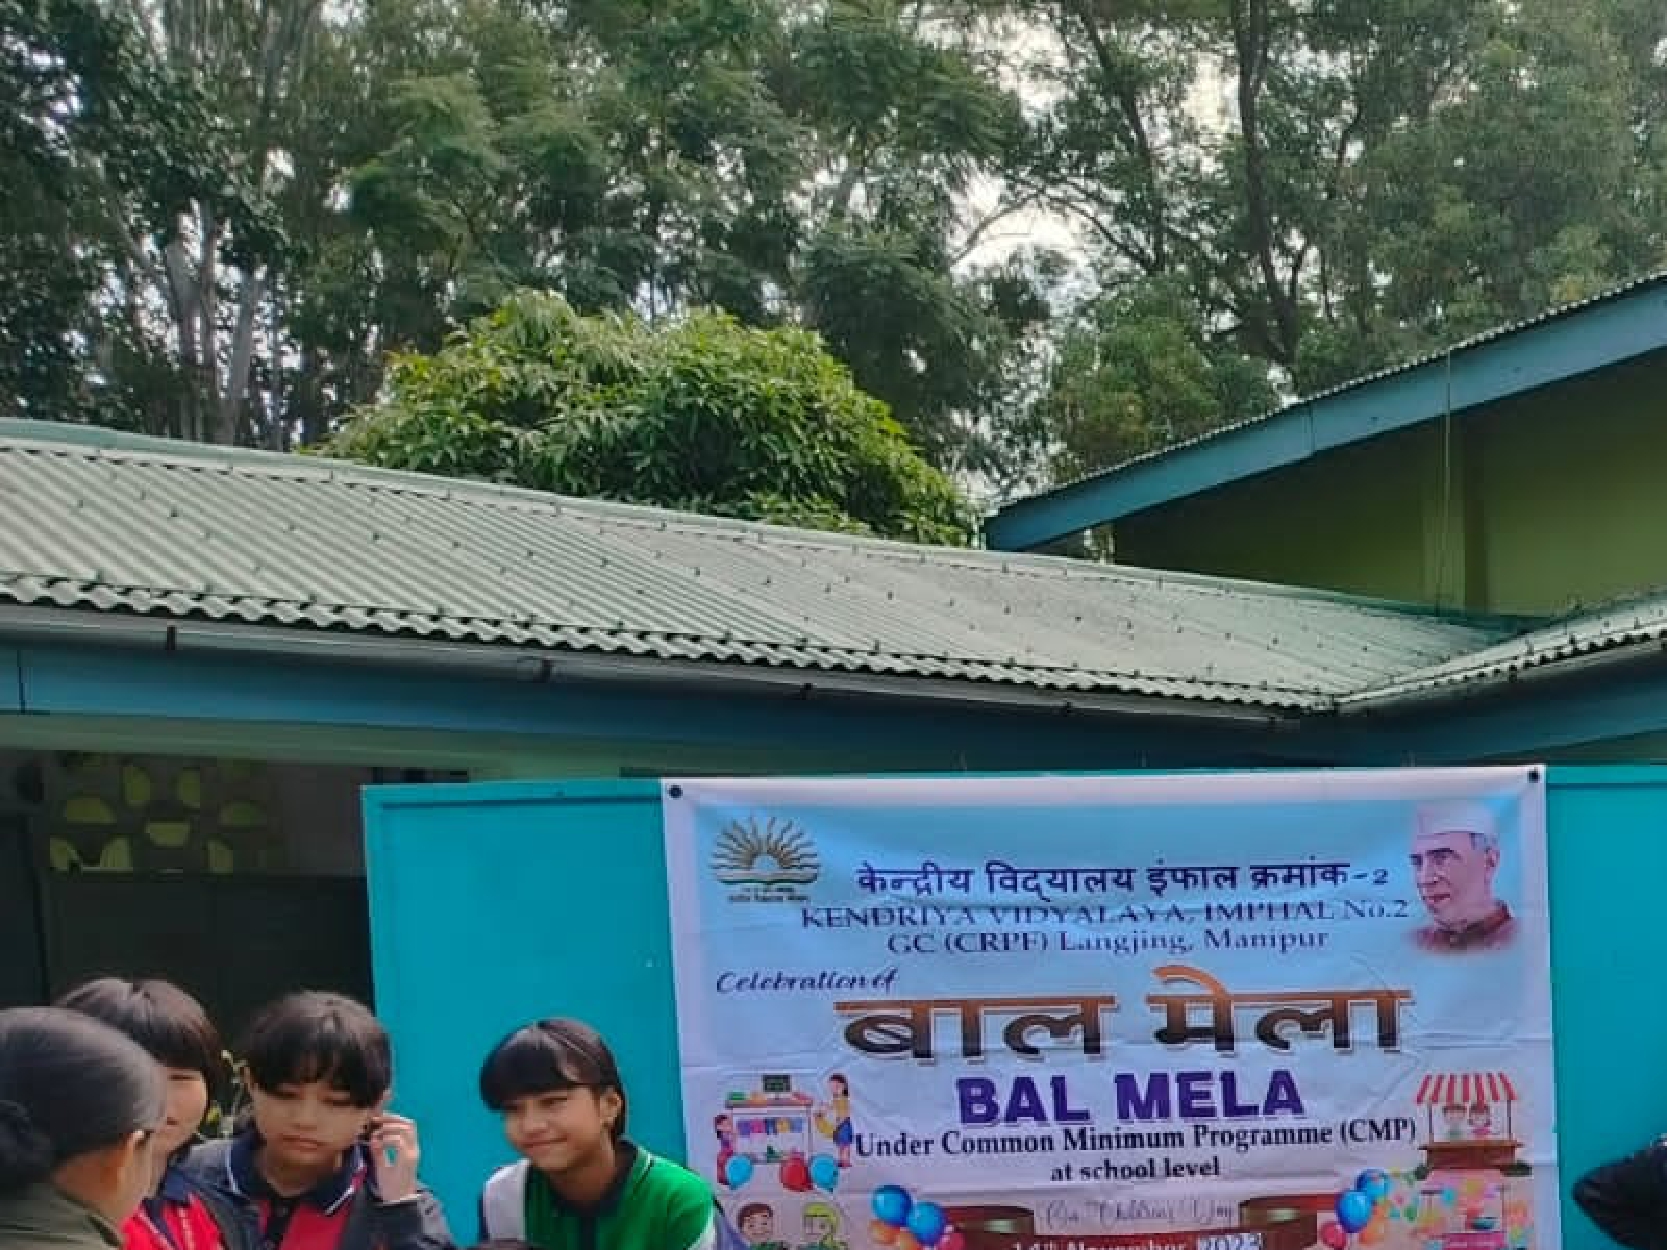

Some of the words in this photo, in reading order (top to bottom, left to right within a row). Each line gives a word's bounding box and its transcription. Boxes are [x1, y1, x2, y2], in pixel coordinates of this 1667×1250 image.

[1146, 857, 1240, 896] इंफाल
[801, 906, 975, 928] KENDRIYA
[887, 932, 935, 953] GC
[944, 932, 1048, 954] (CRPF)
[1203, 928, 1330, 954] Manipur
[715, 968, 866, 994] Celebration
[834, 995, 1117, 1067] बाल
[1144, 964, 1412, 1056] मेला
[956, 1073, 1091, 1126] BAL
[1114, 1069, 1305, 1122] MELA
[854, 1131, 935, 1157] Under
[941, 1129, 1055, 1155] Common
[1062, 1126, 1186, 1151] Minimum
[1193, 1122, 1334, 1152] Programme
[1340, 1116, 1417, 1146] (CMP)
[1050, 1163, 1073, 1182] at
[1079, 1157, 1156, 1181] school
[1164, 1155, 1220, 1178] level
